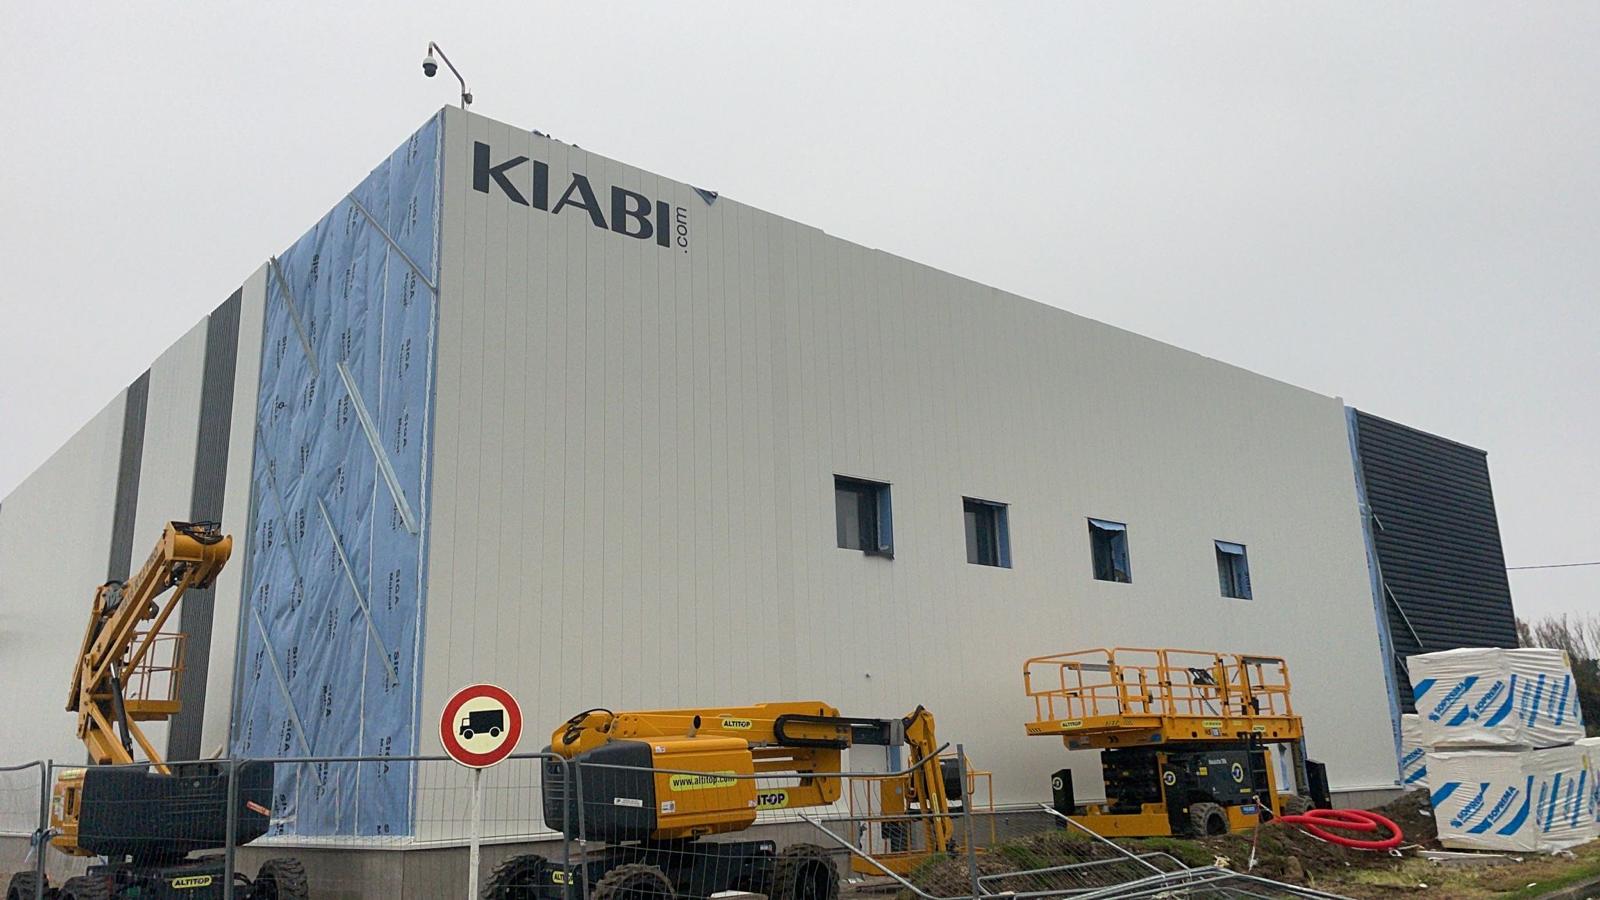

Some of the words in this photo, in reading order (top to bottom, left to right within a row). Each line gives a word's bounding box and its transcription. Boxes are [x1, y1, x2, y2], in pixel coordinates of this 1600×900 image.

[473, 140, 670, 248] KIABI
[676, 207, 687, 254] .com
[308, 378, 316, 408] SIGA
[284, 719, 292, 752] SIGA
[723, 720, 751, 728] ALTITOP
[756, 793, 785, 806] ITOP
[1488, 785, 1517, 820] SOPREMA
[175, 878, 210, 886] ALTITOP
